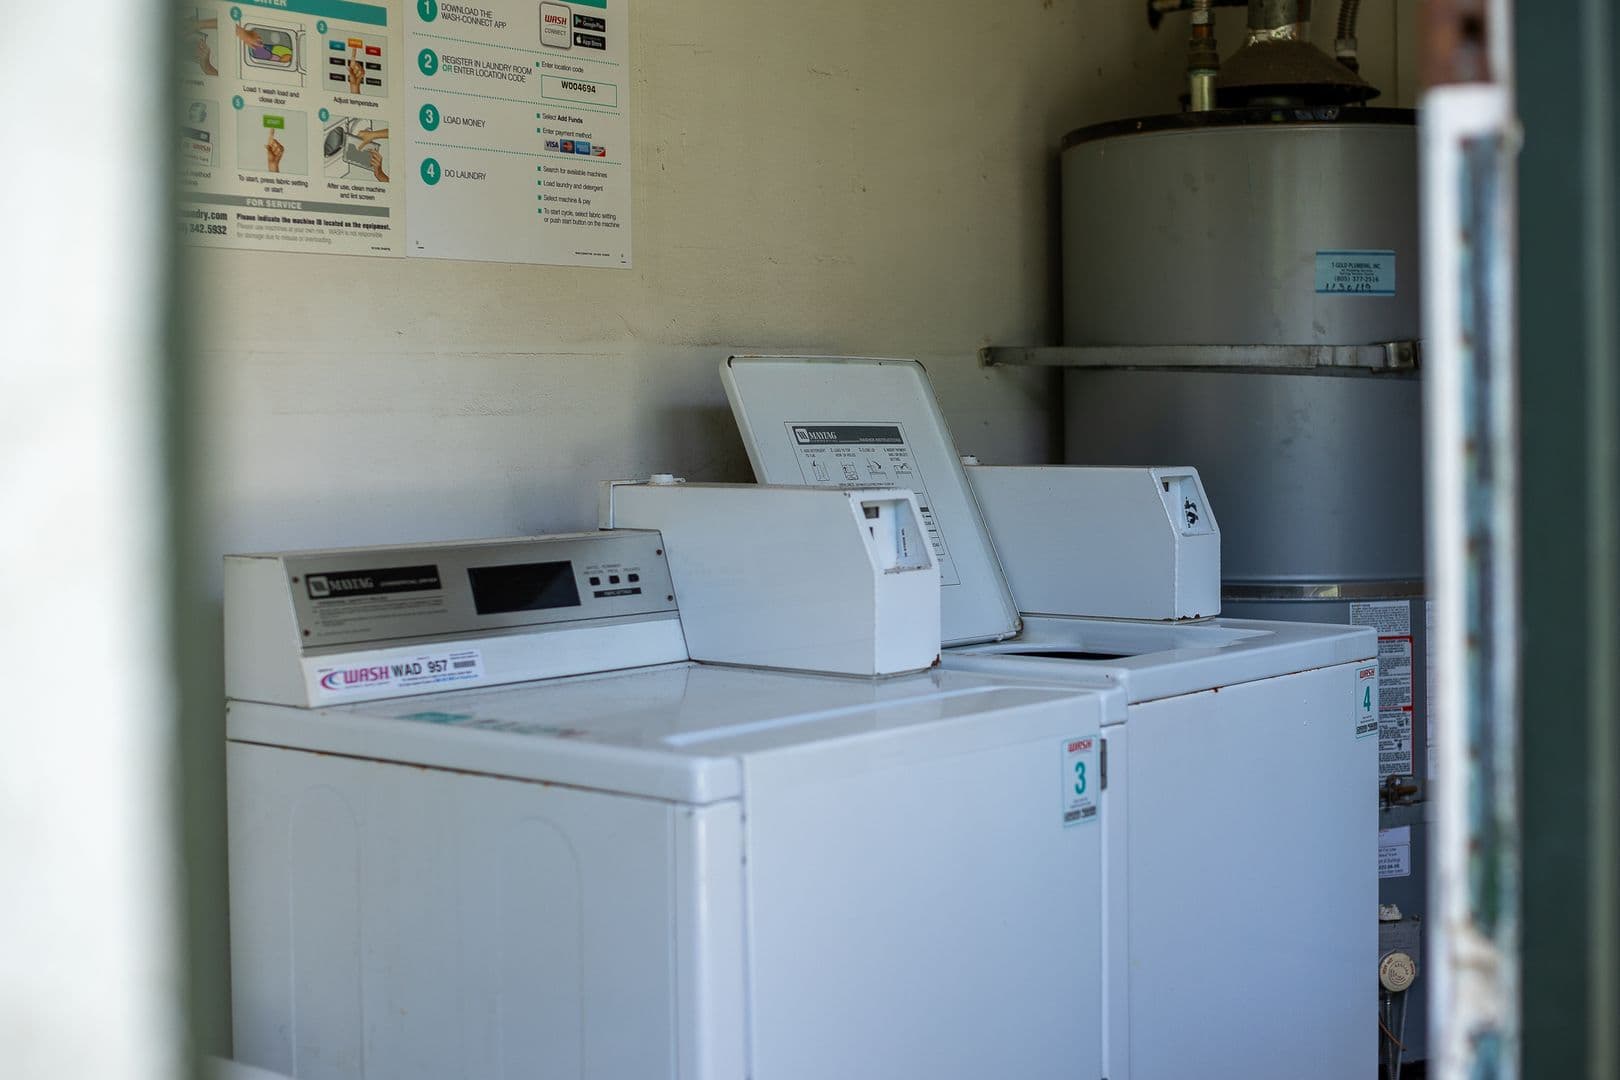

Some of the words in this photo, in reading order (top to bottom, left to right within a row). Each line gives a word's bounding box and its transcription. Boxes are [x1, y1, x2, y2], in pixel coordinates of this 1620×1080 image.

[424, 0, 430, 14] 1
[441, 3, 478, 16] DOWNLOAD
[480, 9, 492, 18] THE
[441, 12, 492, 26] WASH-CONNECT
[494, 20, 506, 28] APP
[544, 14, 567, 25] WASH
[544, 28, 566, 36] CONNECT
[424, 54, 432, 68] 2
[442, 54, 472, 66] REGISTER
[474, 59, 480, 67] IN
[482, 60, 512, 73] LAUNDRY
[513, 66, 532, 75] ROOM
[542, 60, 554, 68] Enter
[554, 63, 572, 71] location
[442, 64, 452, 72] OR
[454, 66, 474, 76] ENTER
[476, 68, 506, 80] LOCATION
[508, 73, 526, 82] CODE
[561, 80, 596, 93] W004694
[334, 96, 348, 104] Adjust
[350, 98, 378, 108] temperature
[426, 109, 434, 124] 3
[444, 116, 462, 124] LOAD
[462, 118, 486, 128] MONEY
[426, 164, 434, 178] 4
[444, 170, 456, 178] DO
[456, 170, 486, 180] LAUNDRY
[556, 182, 572, 190] laundry
[246, 198, 264, 207] FOR
[266, 200, 302, 210] SERVICE
[236, 213, 255, 221] Please
[808, 431, 838, 440] MAYTAG
[344, 666, 389, 684] WASH
[391, 662, 422, 677] WAD
[427, 660, 448, 673] 957
[1364, 686, 1371, 712] 4
[1075, 761, 1086, 794] 3
